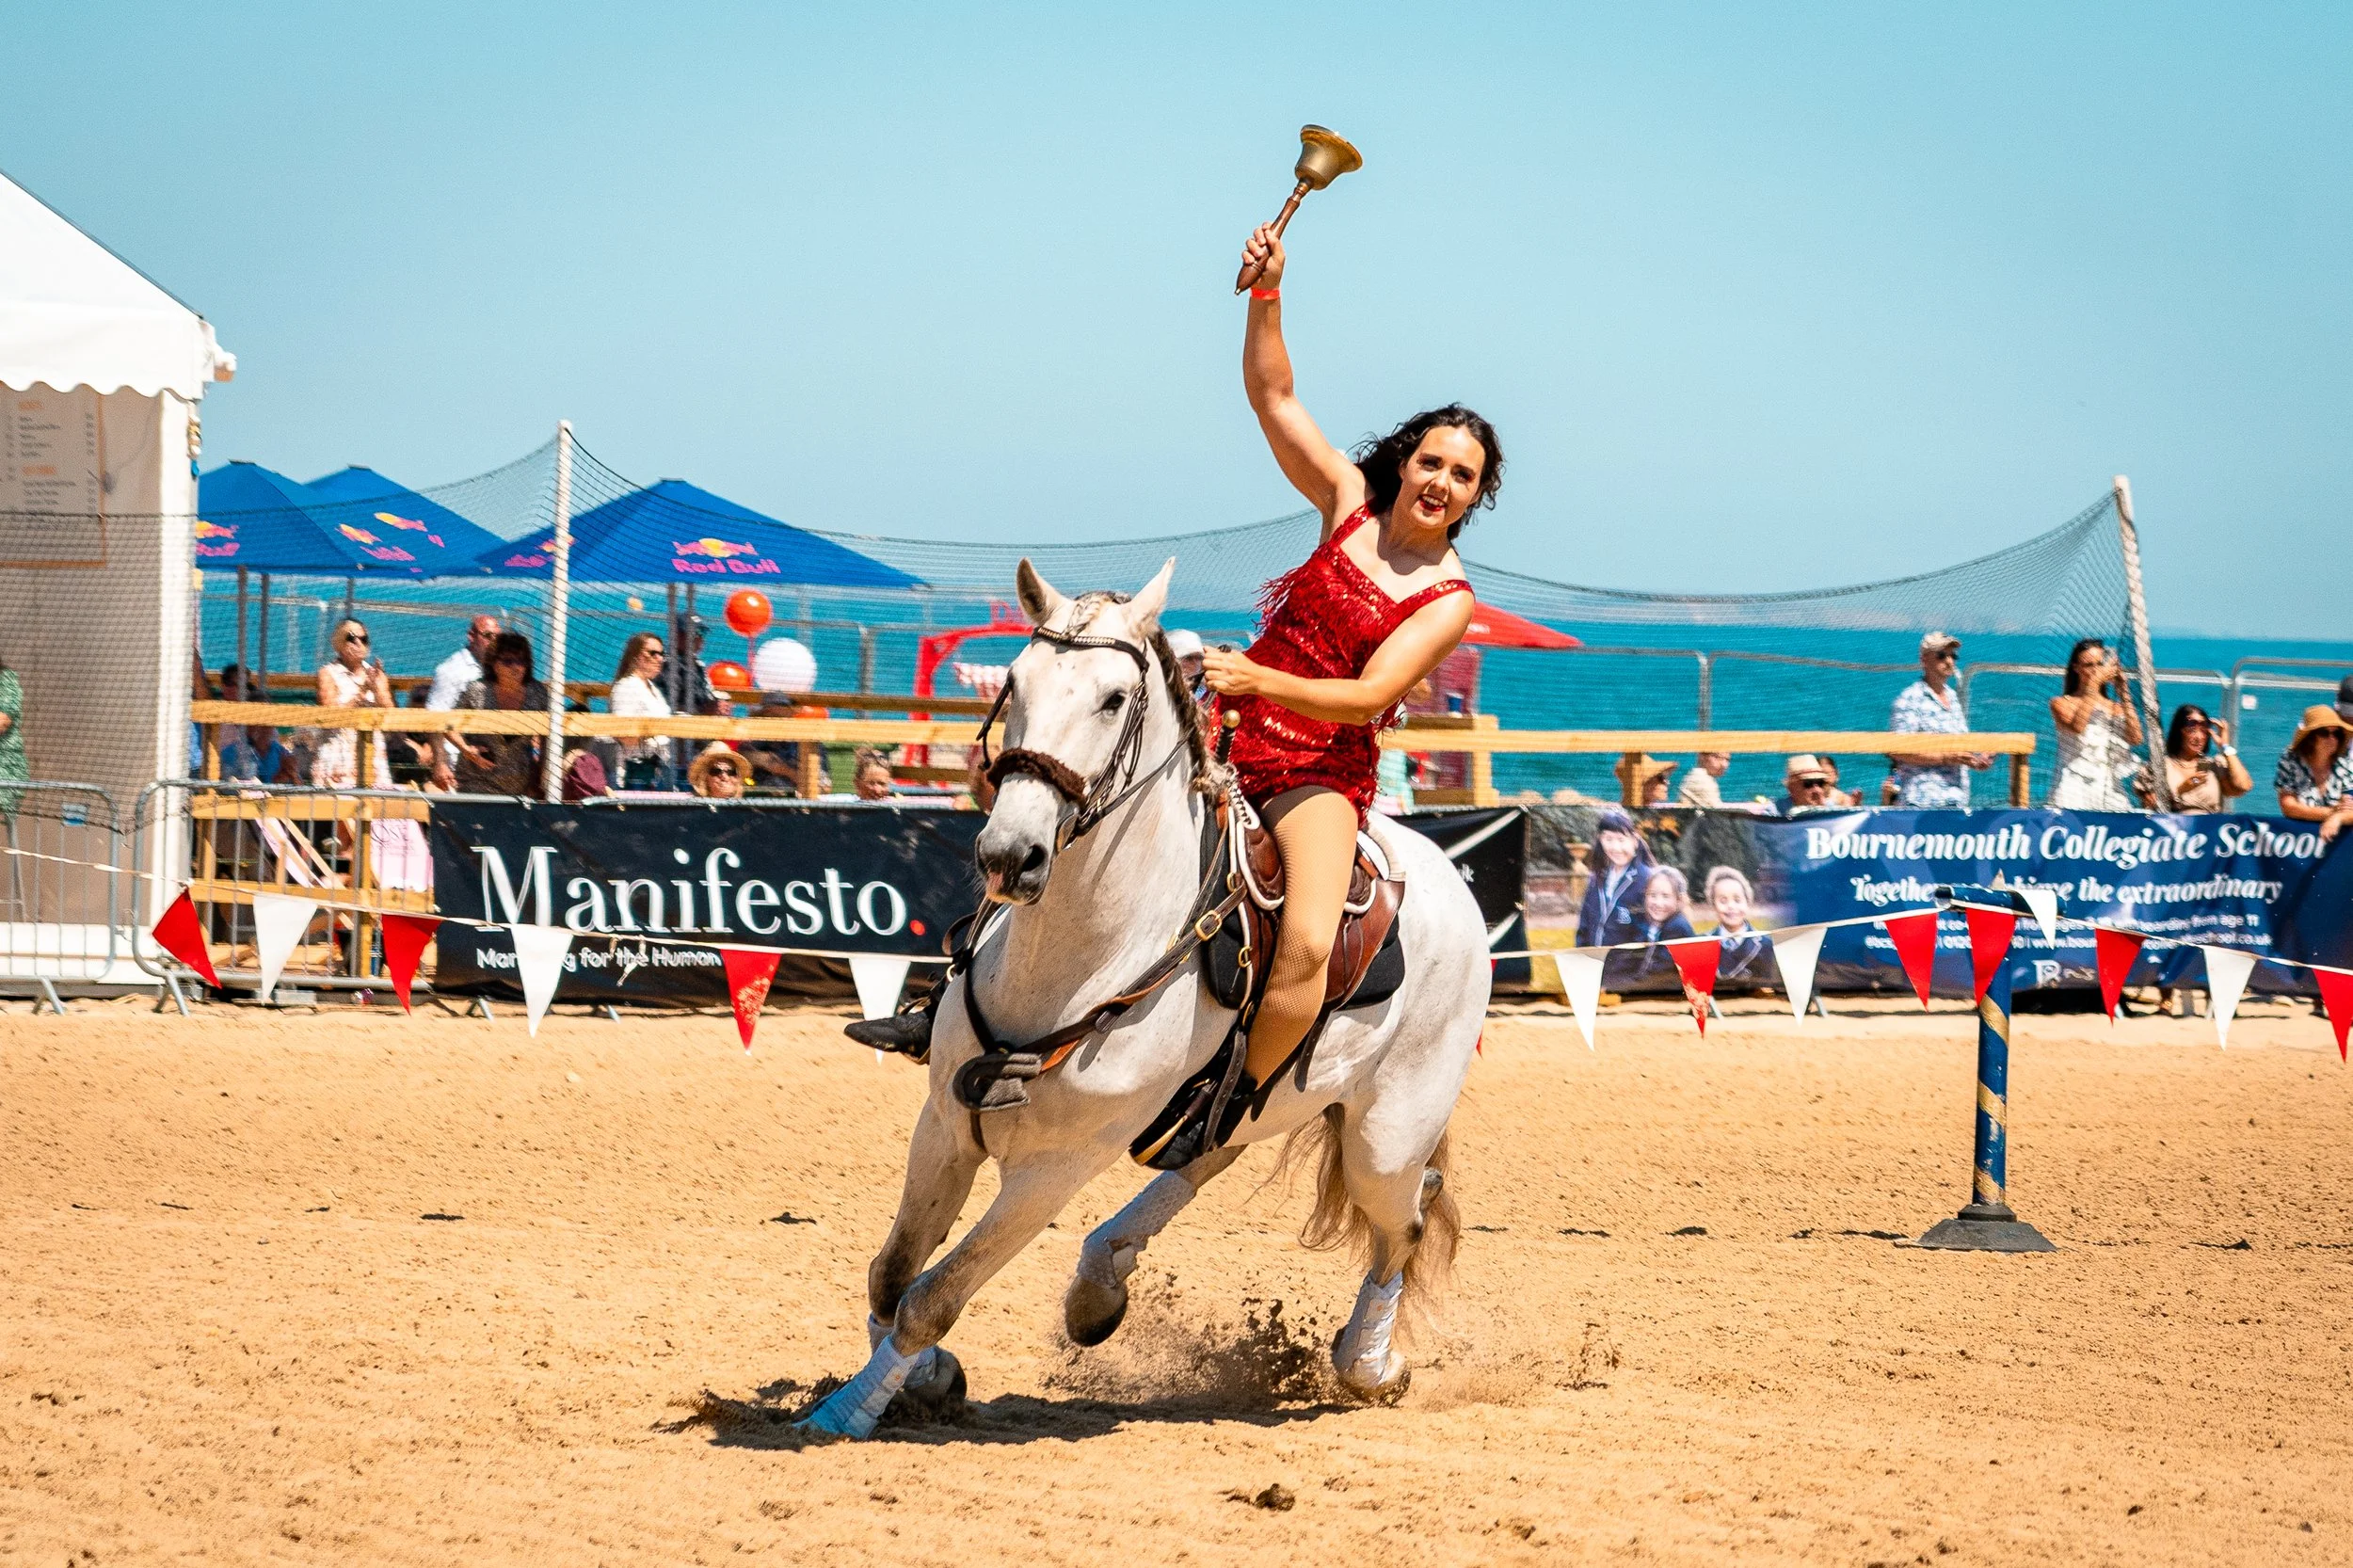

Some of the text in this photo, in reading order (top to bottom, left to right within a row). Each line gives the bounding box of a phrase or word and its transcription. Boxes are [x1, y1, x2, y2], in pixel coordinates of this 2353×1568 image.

[671, 558, 726, 574] Red
[1805, 824, 2031, 861] Bournemouth
[2040, 824, 2207, 870] Collegiate
[469, 845, 926, 936] Manifesto.
[2078, 876, 2114, 904] the
[2117, 873, 2283, 904] extraordinary
[2219, 914, 2245, 929] age
[580, 947, 611, 968] for
[615, 947, 649, 968] the
